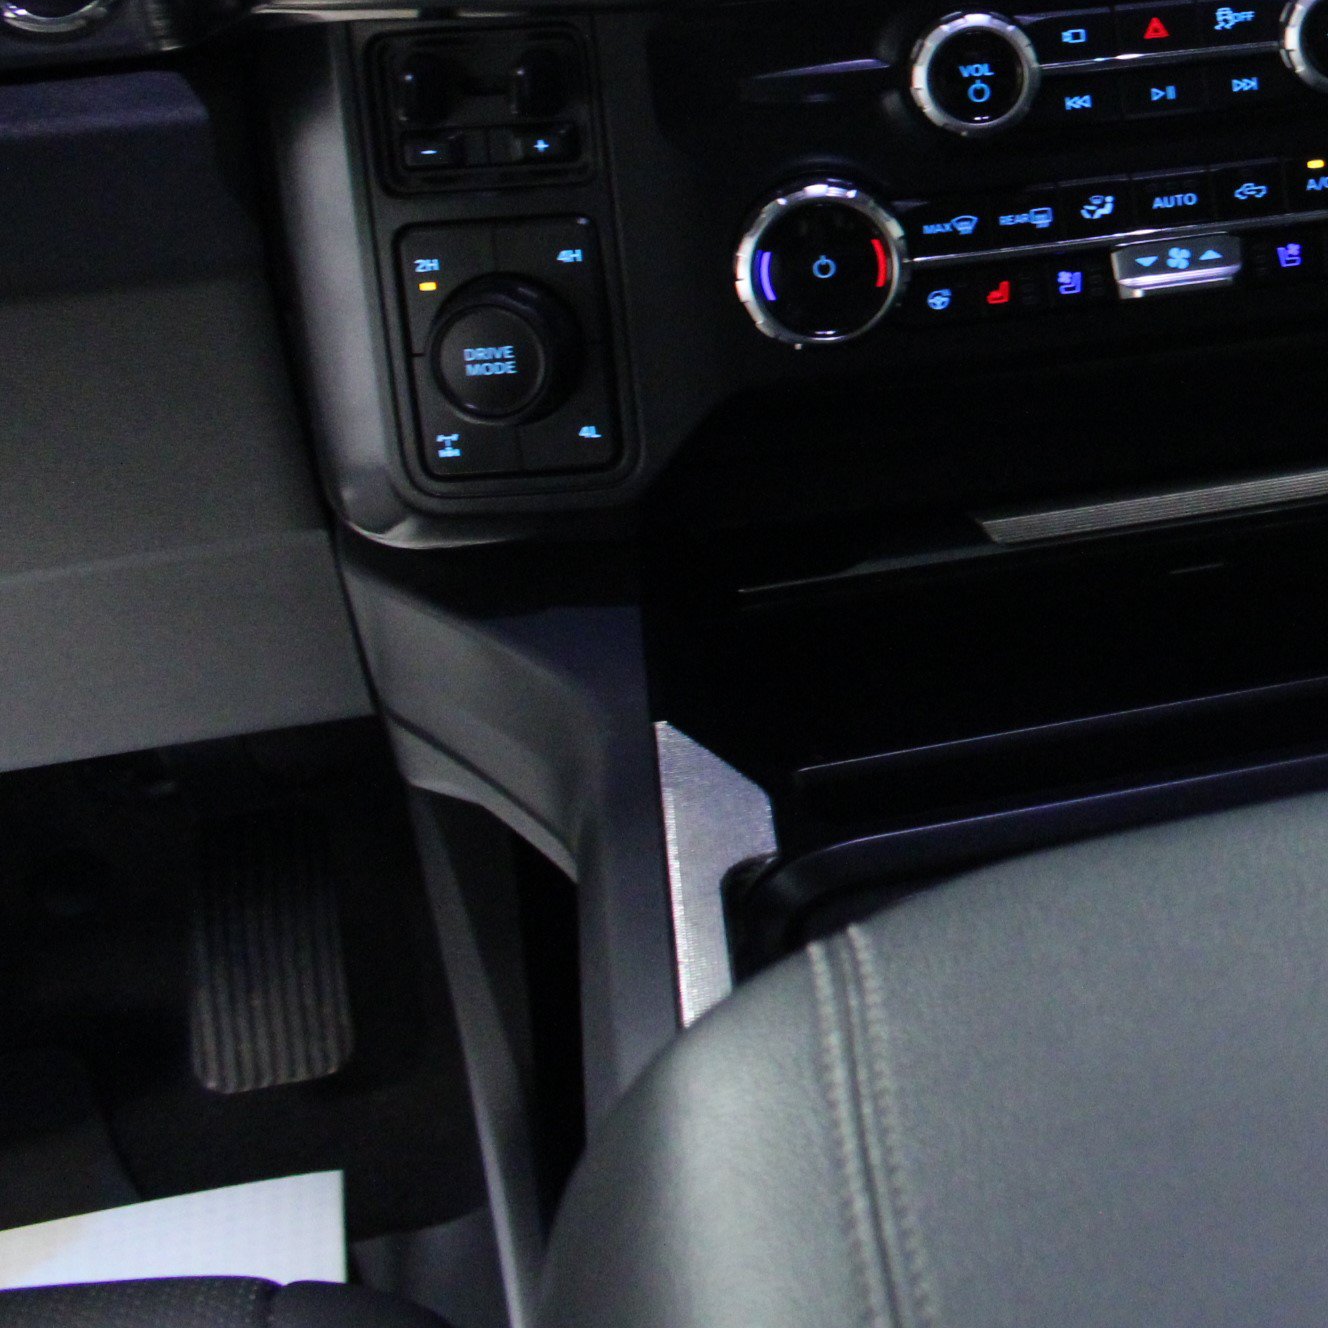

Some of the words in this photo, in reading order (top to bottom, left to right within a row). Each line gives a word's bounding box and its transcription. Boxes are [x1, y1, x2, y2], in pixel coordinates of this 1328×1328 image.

[958, 63, 995, 77] VOL
[1152, 192, 1198, 209] AUTO
[999, 213, 1030, 227] REAR
[922, 222, 951, 236] MAX
[556, 249, 583, 263] 4H
[414, 259, 440, 273] 2H
[463, 345, 515, 361] DRIVE
[466, 361, 517, 376] MODE
